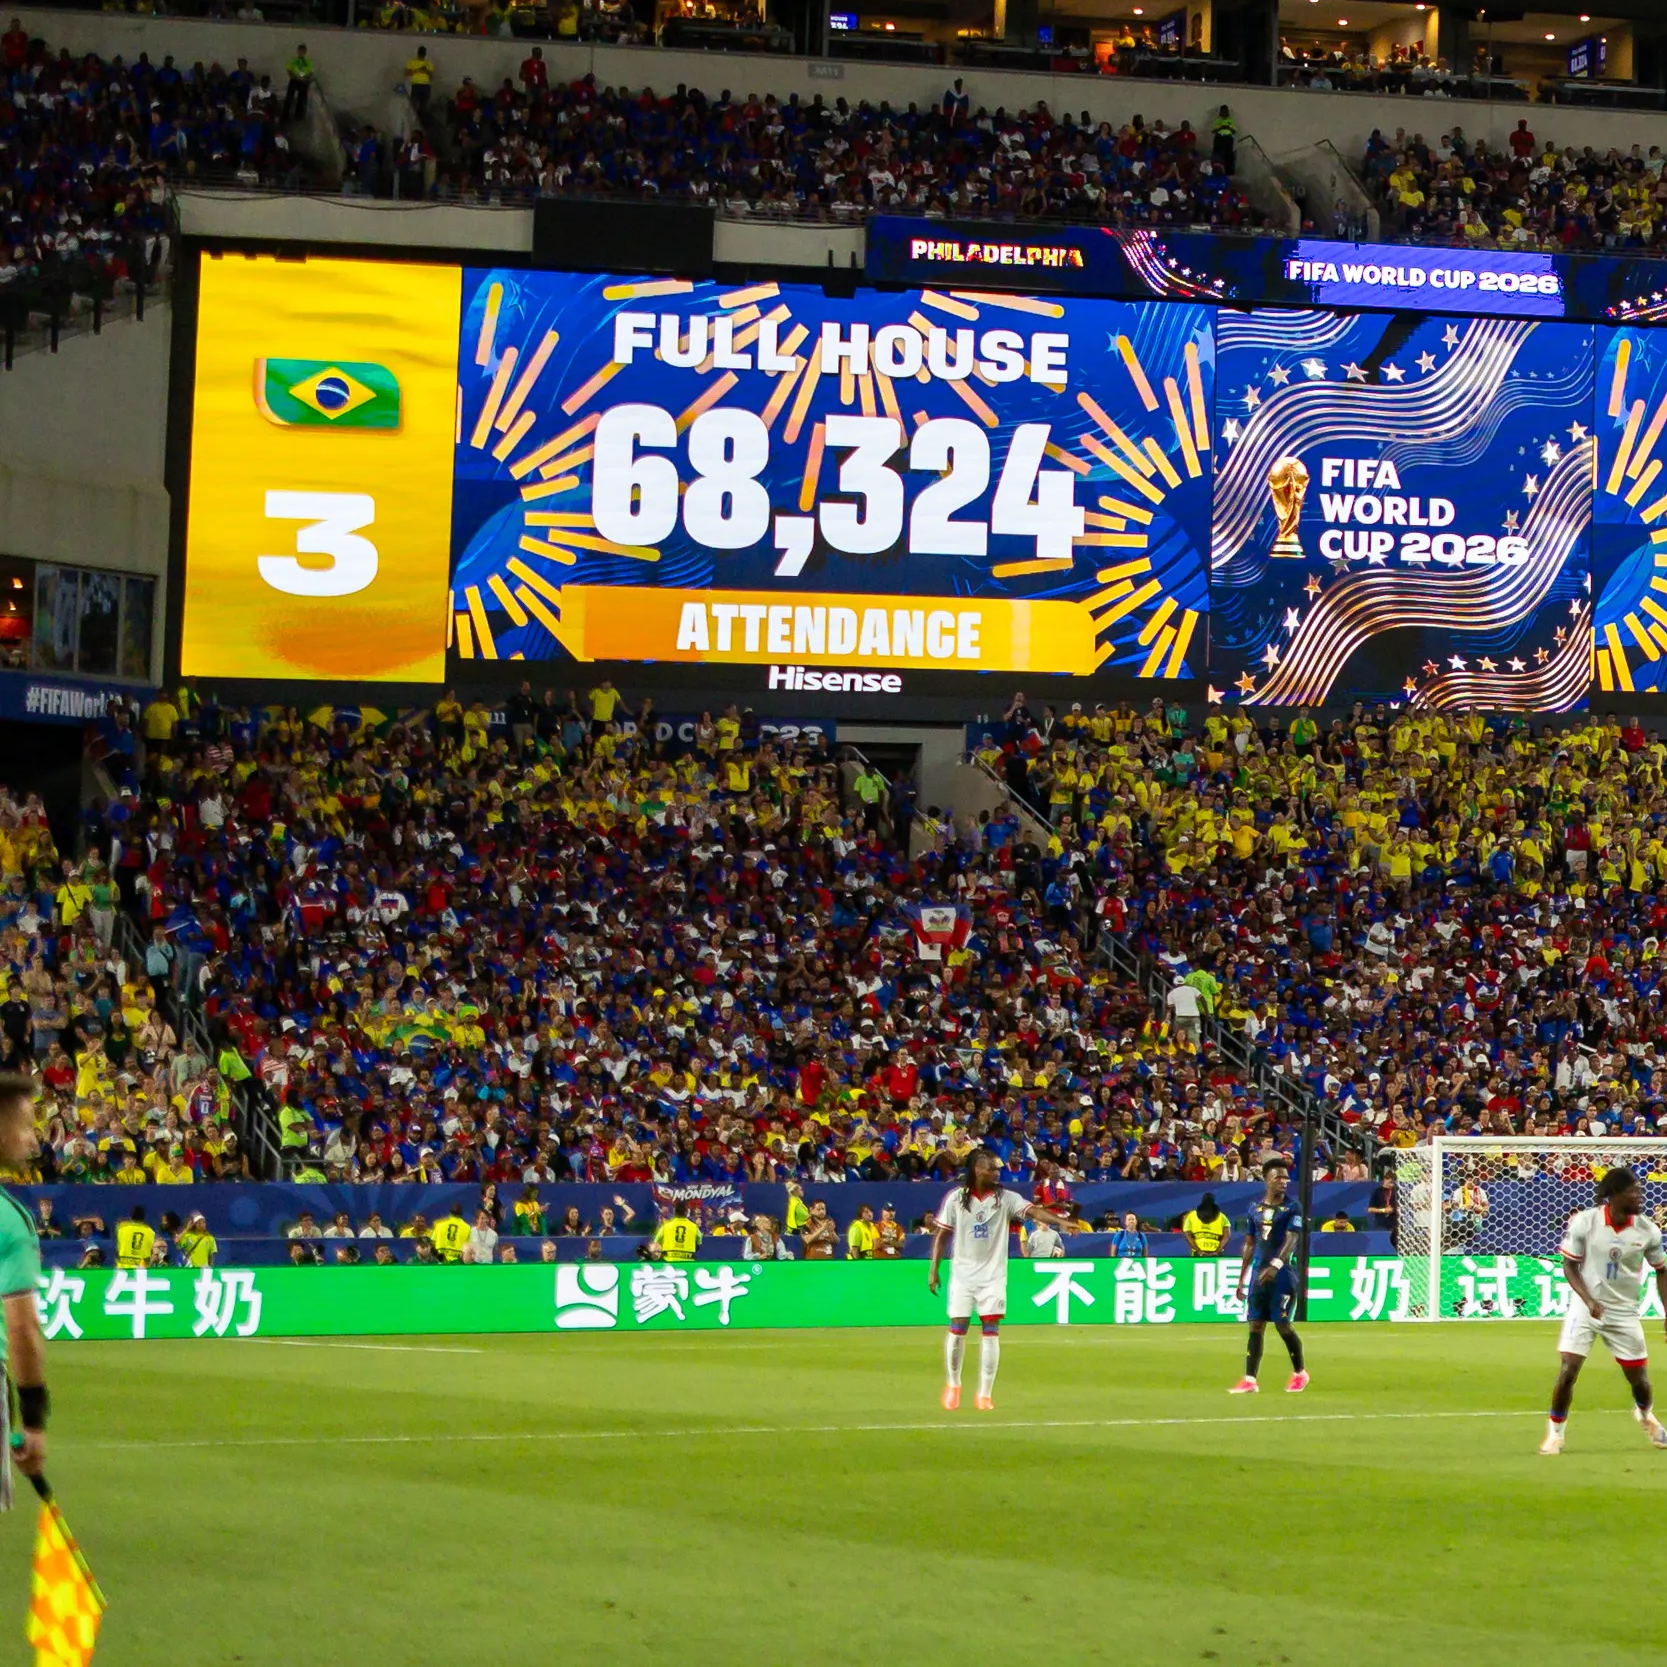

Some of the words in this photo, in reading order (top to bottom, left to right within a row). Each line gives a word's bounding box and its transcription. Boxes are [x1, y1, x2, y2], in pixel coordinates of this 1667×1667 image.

[911, 239, 1084, 268] PHILADELPHIA
[1289, 260, 1339, 284] FIFA
[1342, 264, 1426, 289] WORLD
[1429, 268, 1476, 291] CUP
[1478, 271, 1560, 295] 2026
[614, 312, 796, 372] FULL
[820, 322, 1070, 385] HOUSE
[592, 403, 1086, 576] 68,324
[1321, 457, 1401, 490] FIFA
[1320, 495, 1455, 528] WORLD
[257, 490, 379, 597] 3
[1319, 529, 1396, 563] CUP
[1400, 533, 1531, 567] 2026
[676, 602, 982, 659] ATTENDANCE
[767, 665, 902, 694] Hisense
[673, 1185, 736, 1202] MONDYAL
[1262, 1225, 1273, 1241] 7
[1606, 1261, 1619, 1280] 11
[630, 1262, 753, 1325] 蒙牛
[1282, 1294, 1291, 1310] 7
